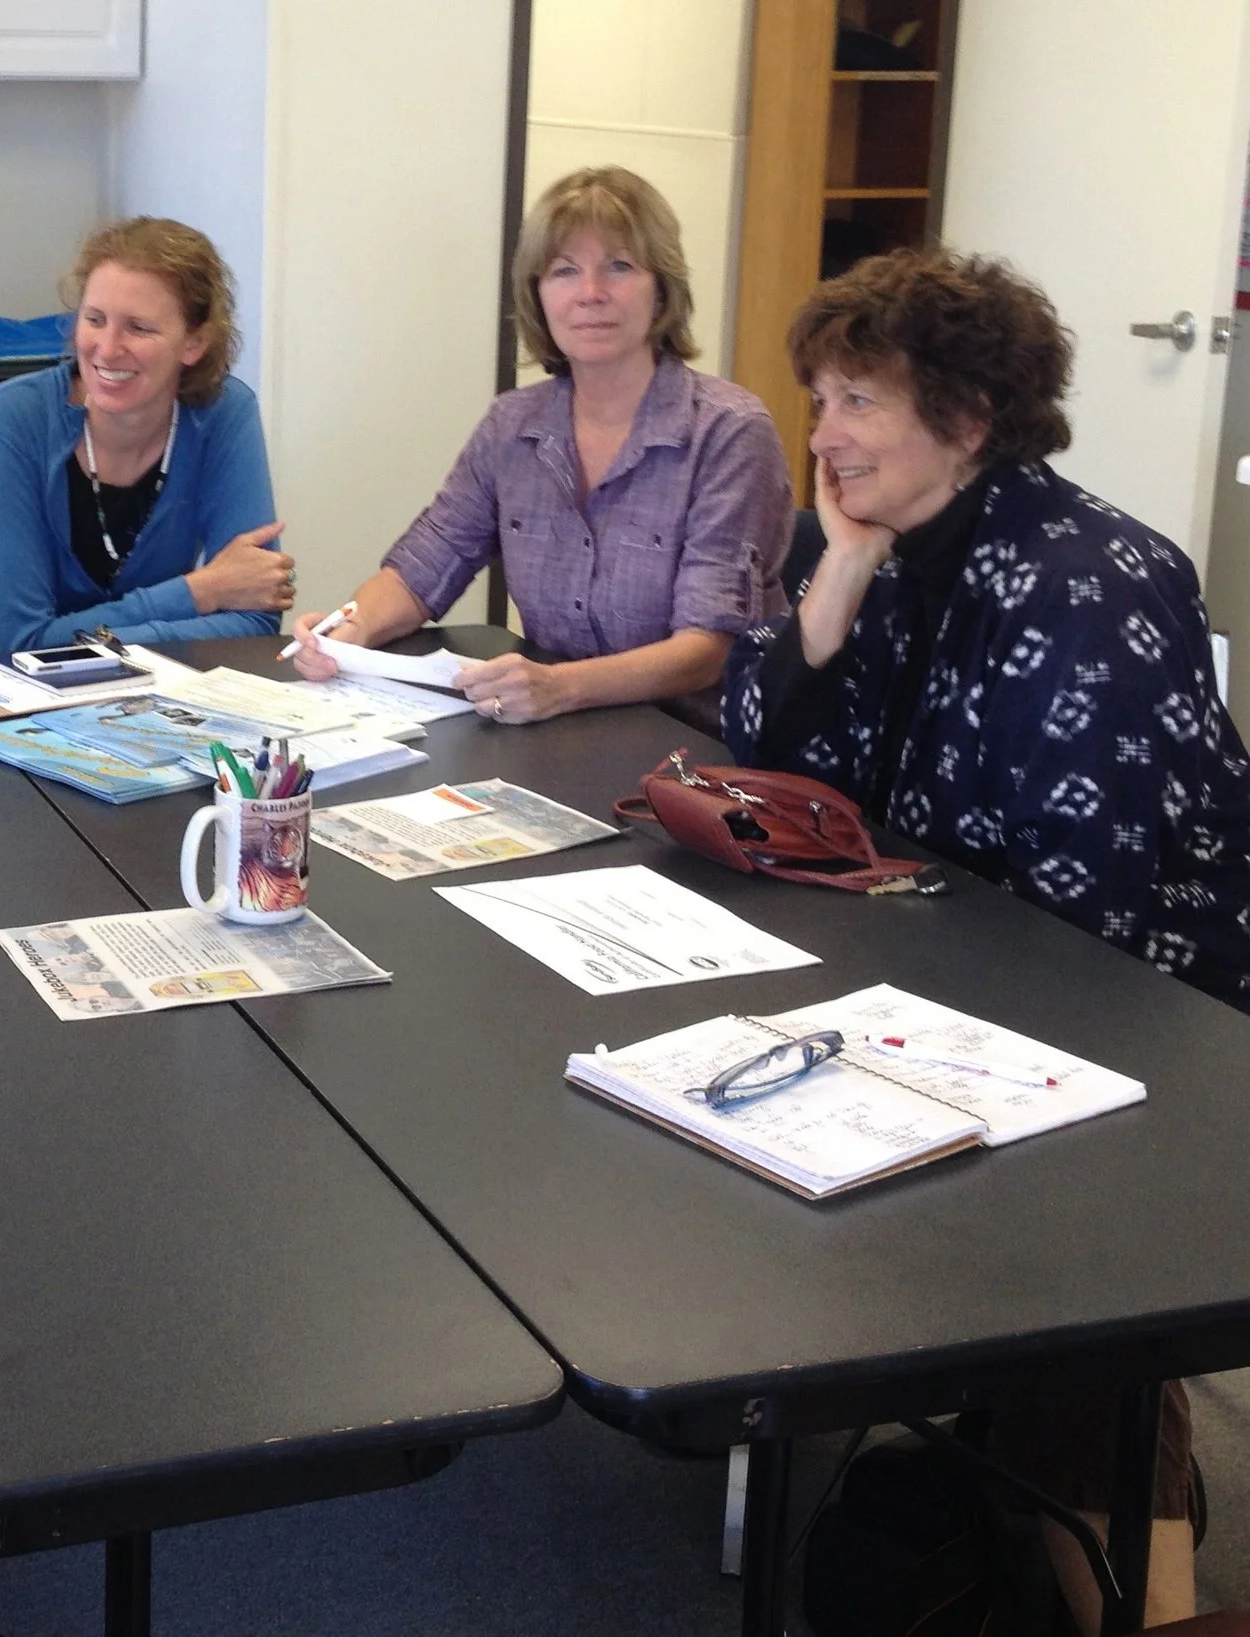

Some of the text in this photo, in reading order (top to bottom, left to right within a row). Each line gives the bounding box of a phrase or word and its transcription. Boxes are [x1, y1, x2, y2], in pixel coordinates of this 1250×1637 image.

[251, 803, 287, 813] CHARLES
[14, 938, 78, 1003] Jukebox Heroes
